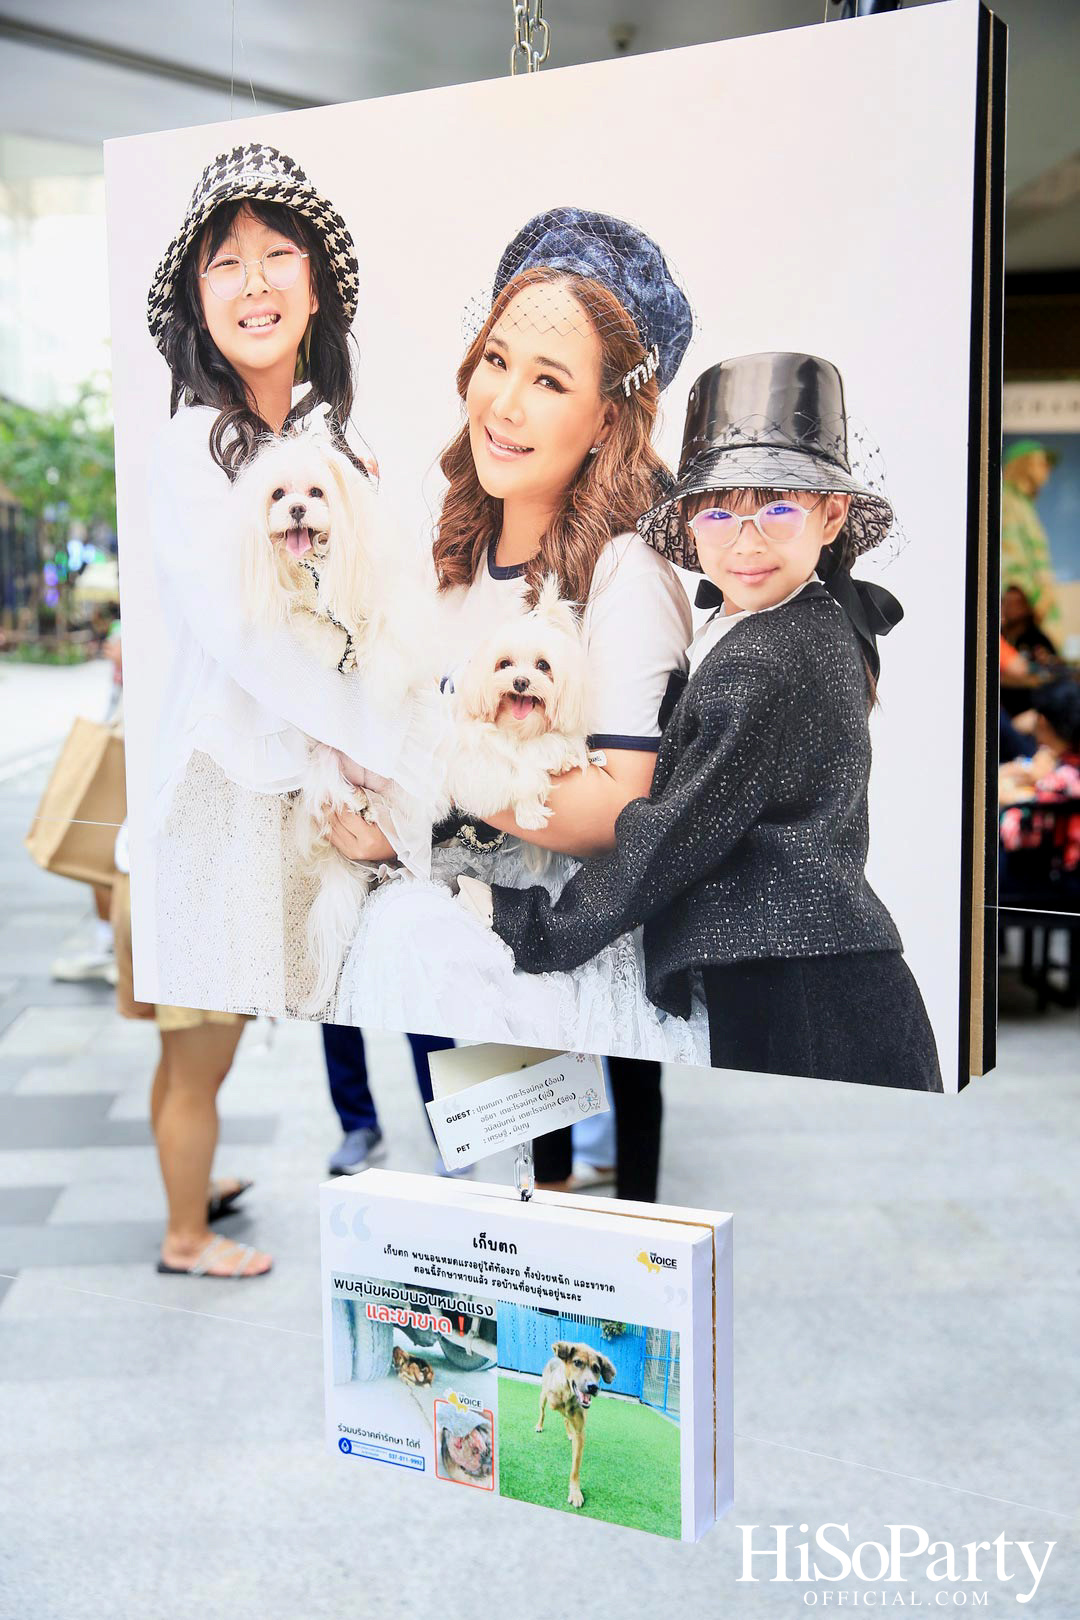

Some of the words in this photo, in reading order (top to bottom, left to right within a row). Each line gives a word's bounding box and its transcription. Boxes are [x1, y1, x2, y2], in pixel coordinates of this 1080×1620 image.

[446, 1109, 471, 1124] GUEST
[456, 1143, 471, 1154] PET
[473, 1232, 518, 1255] เก็บตก
[383, 1244, 409, 1258] เก็บตก
[573, 1279, 616, 1293] และขาขาด
[650, 1255, 677, 1268] VOICE
[333, 1278, 494, 1317] พบสุนัขผอมนอนหมดแรง
[367, 1303, 451, 1334] และขาขาด
[459, 1397, 482, 1408] VOICE
